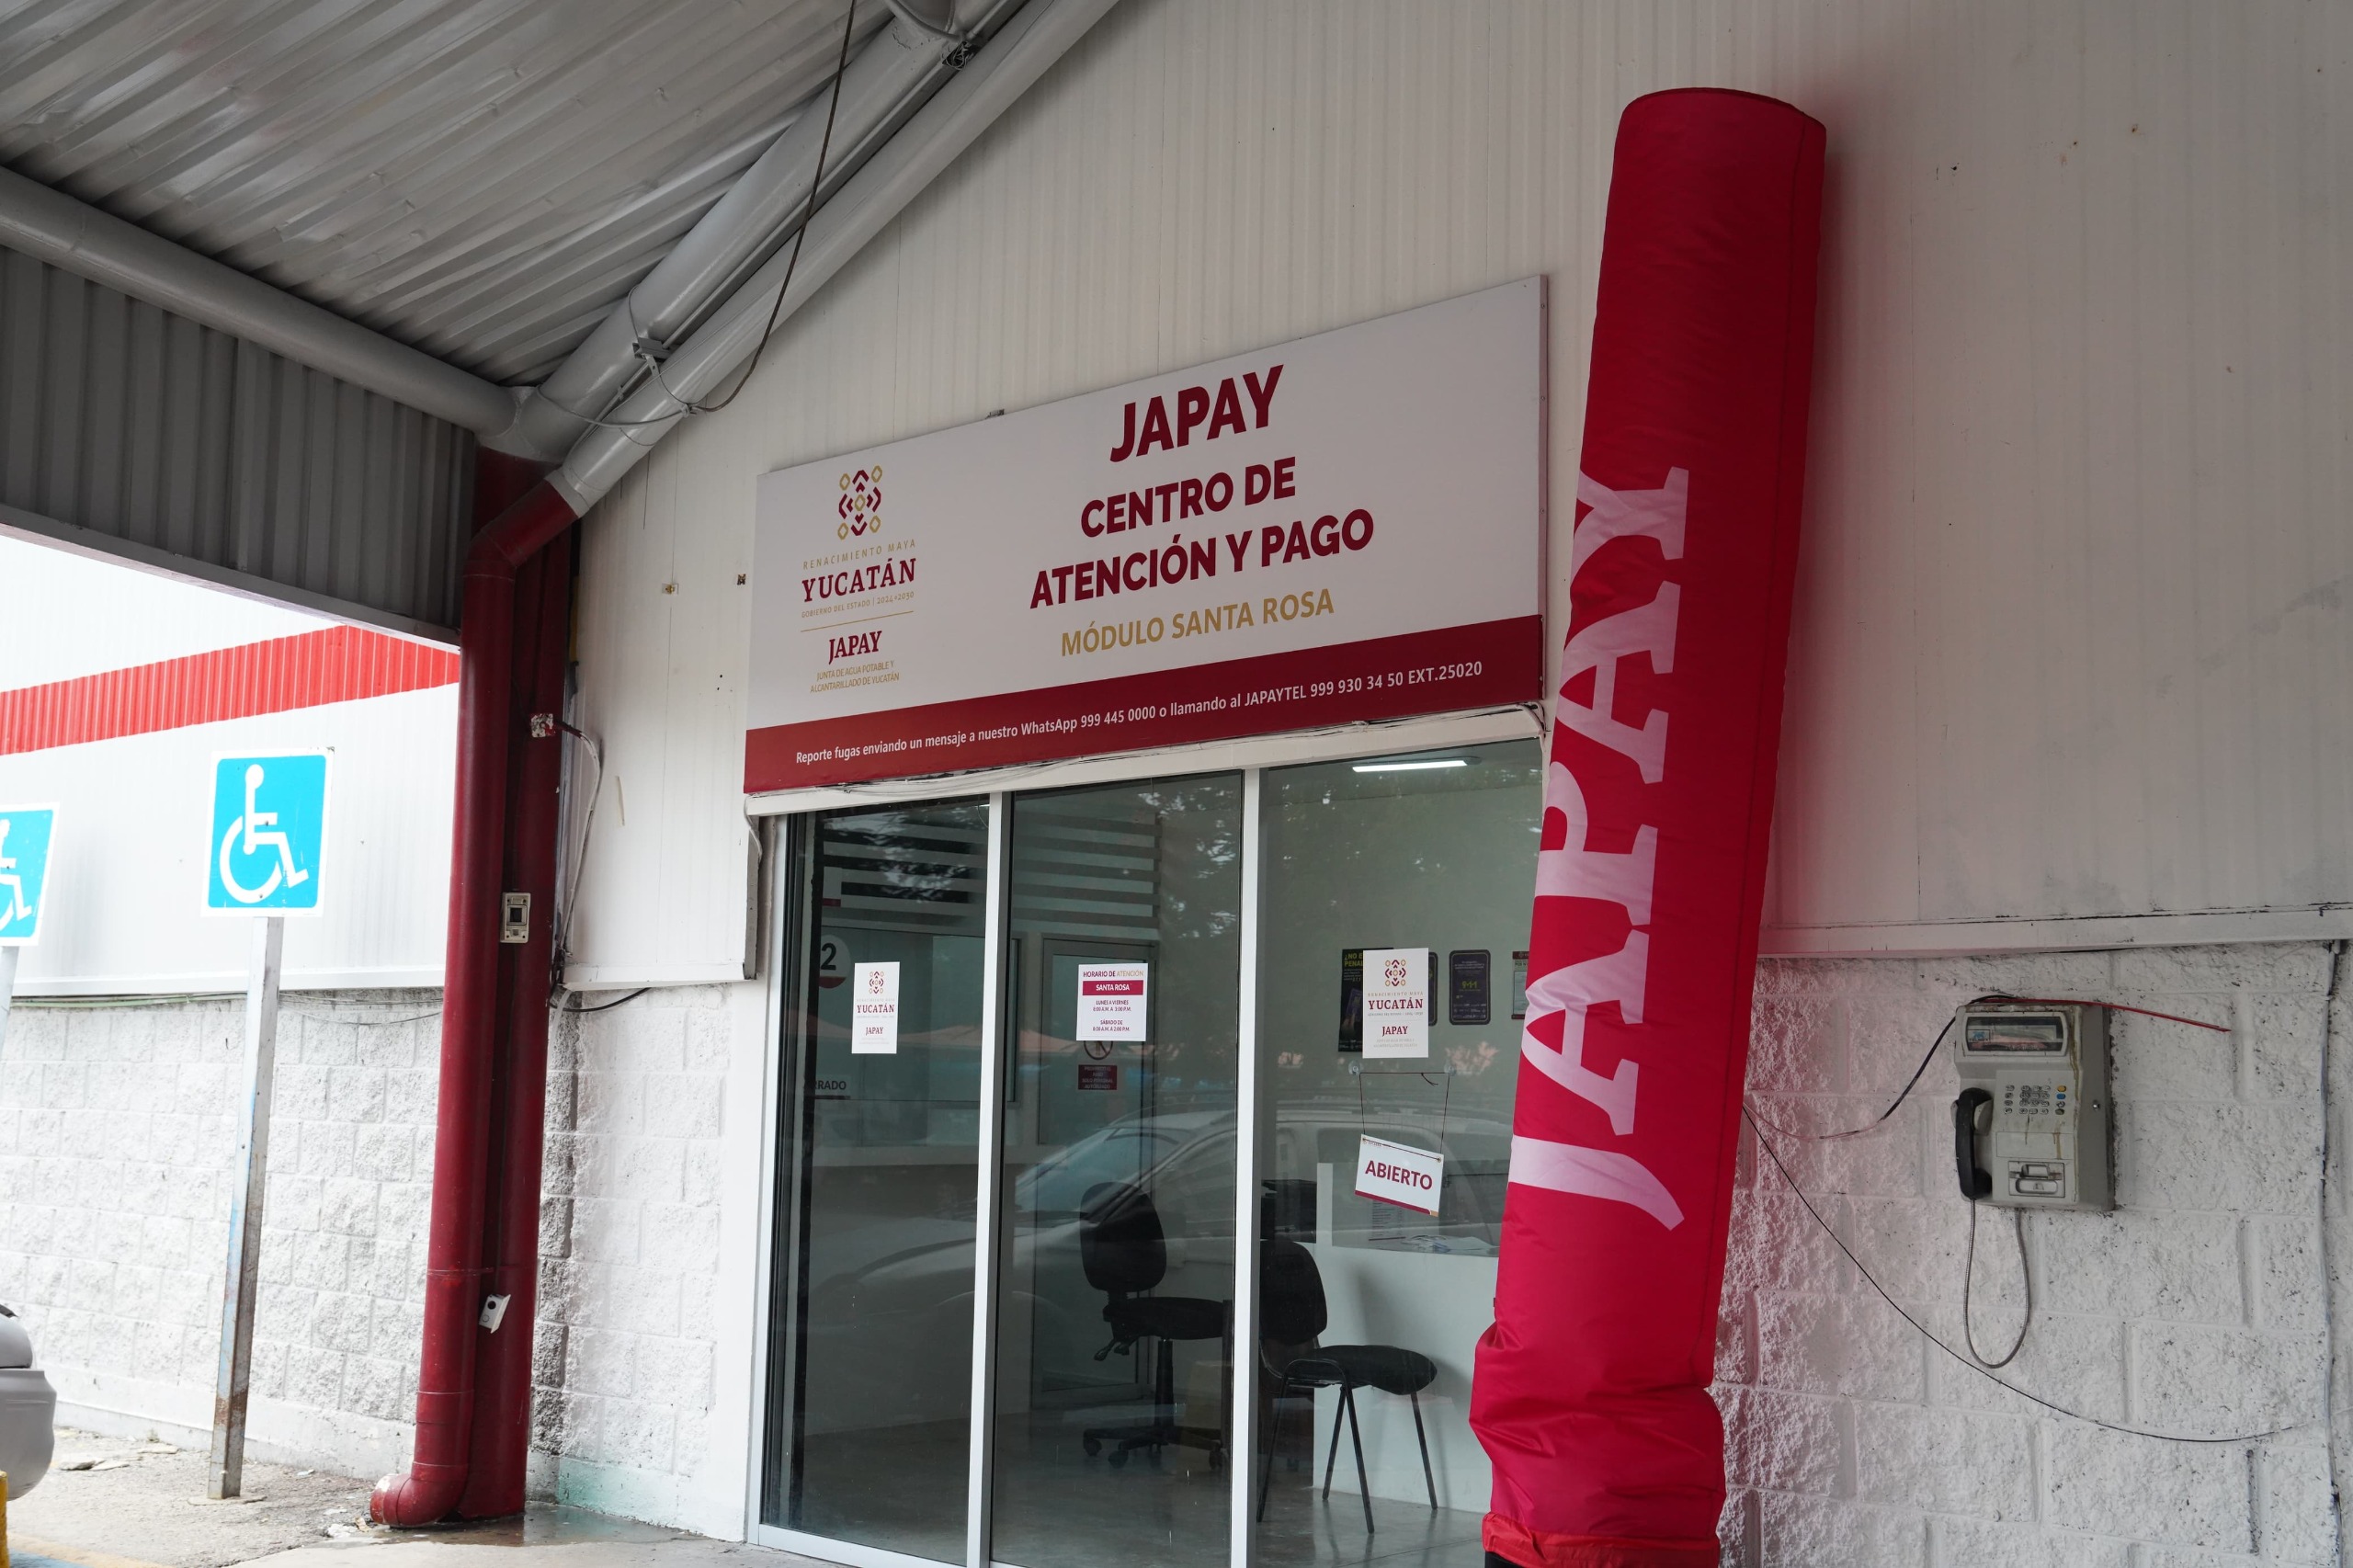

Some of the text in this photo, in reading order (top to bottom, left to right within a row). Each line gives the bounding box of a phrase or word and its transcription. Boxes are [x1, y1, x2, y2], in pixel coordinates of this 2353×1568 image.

[1109, 364, 1284, 463] JAPAY
[1080, 456, 1296, 538] CENTRO DE
[802, 539, 915, 570] RENACIMIENTO MAYA
[1029, 508, 1374, 609] ATENCIÓN Y PAGO
[801, 558, 916, 603] YUCATÁN
[801, 606, 832, 619] GOBIERNO
[834, 604, 845, 612] DEL
[847, 599, 870, 610] ESTADO
[1062, 588, 1335, 657] MÓDULO SANTA ROSA
[828, 631, 882, 665] JAPAY
[810, 672, 900, 693] ALCANTARILLADO DE YUCATÁN
[817, 660, 894, 681] JUNTA DE AGUA POTABLE Y
[796, 661, 1483, 766] Reporte fugas enviando un mensaje a nuestro WhatsApp 999 445 0000 o llamando al JAPAYTEL 999 930 34 50 EXT.25020
[1507, 466, 1689, 1232] JAPAY
[821, 942, 836, 971] 2
[857, 1004, 894, 1014] YUCATÁN
[1369, 997, 1423, 1010] YUCATÁN
[866, 1027, 883, 1036] JAPAY
[1381, 1026, 1408, 1037] JAPAY
[1365, 1160, 1433, 1190] ABIERTO
